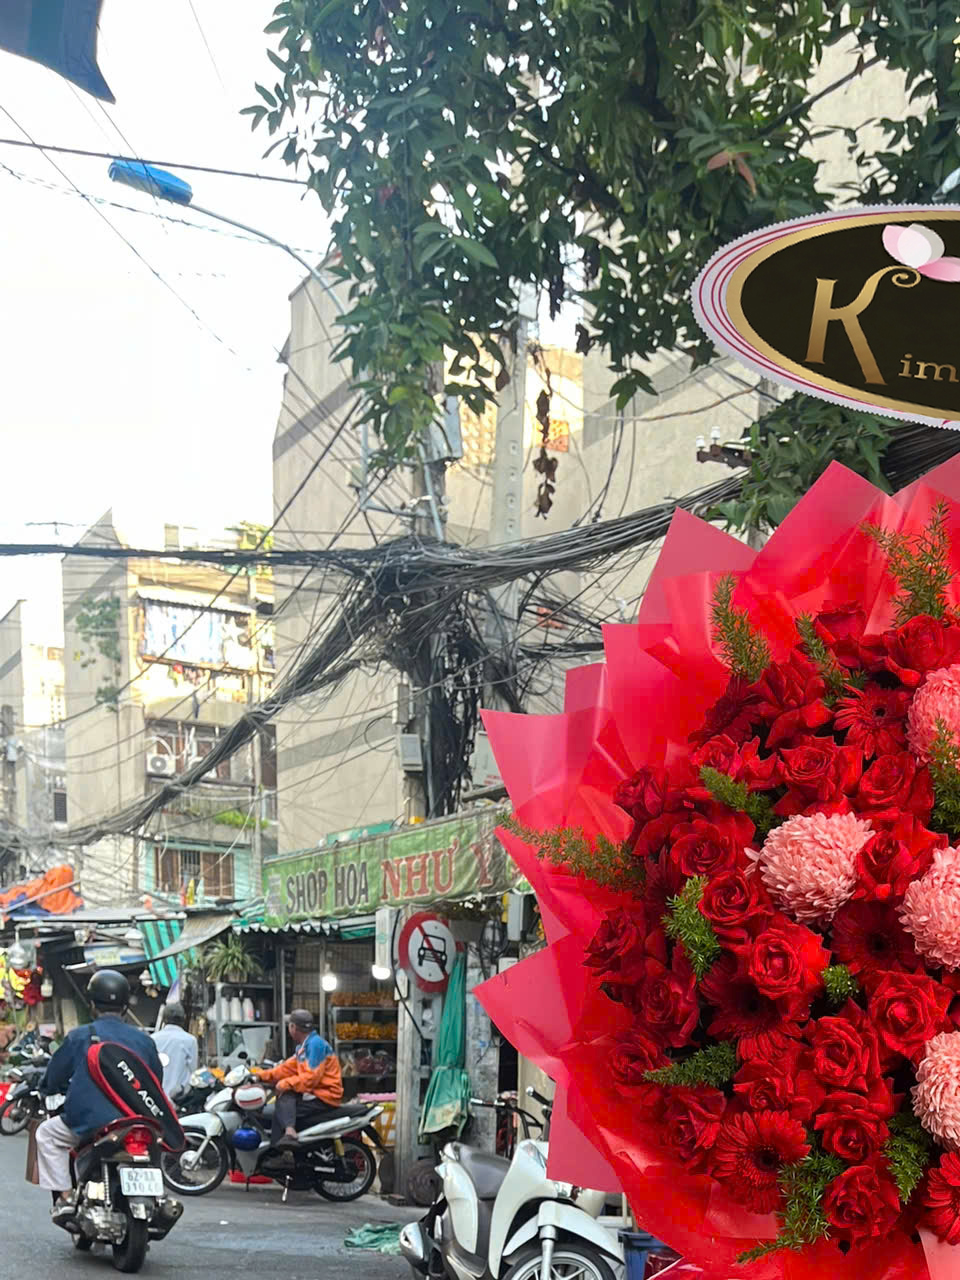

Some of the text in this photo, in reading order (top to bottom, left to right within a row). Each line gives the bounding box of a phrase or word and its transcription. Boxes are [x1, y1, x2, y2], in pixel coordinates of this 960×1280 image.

[286, 868, 328, 916] SHOP
[334, 860, 369, 908] HOA
[381, 836, 459, 900] NHƯ
